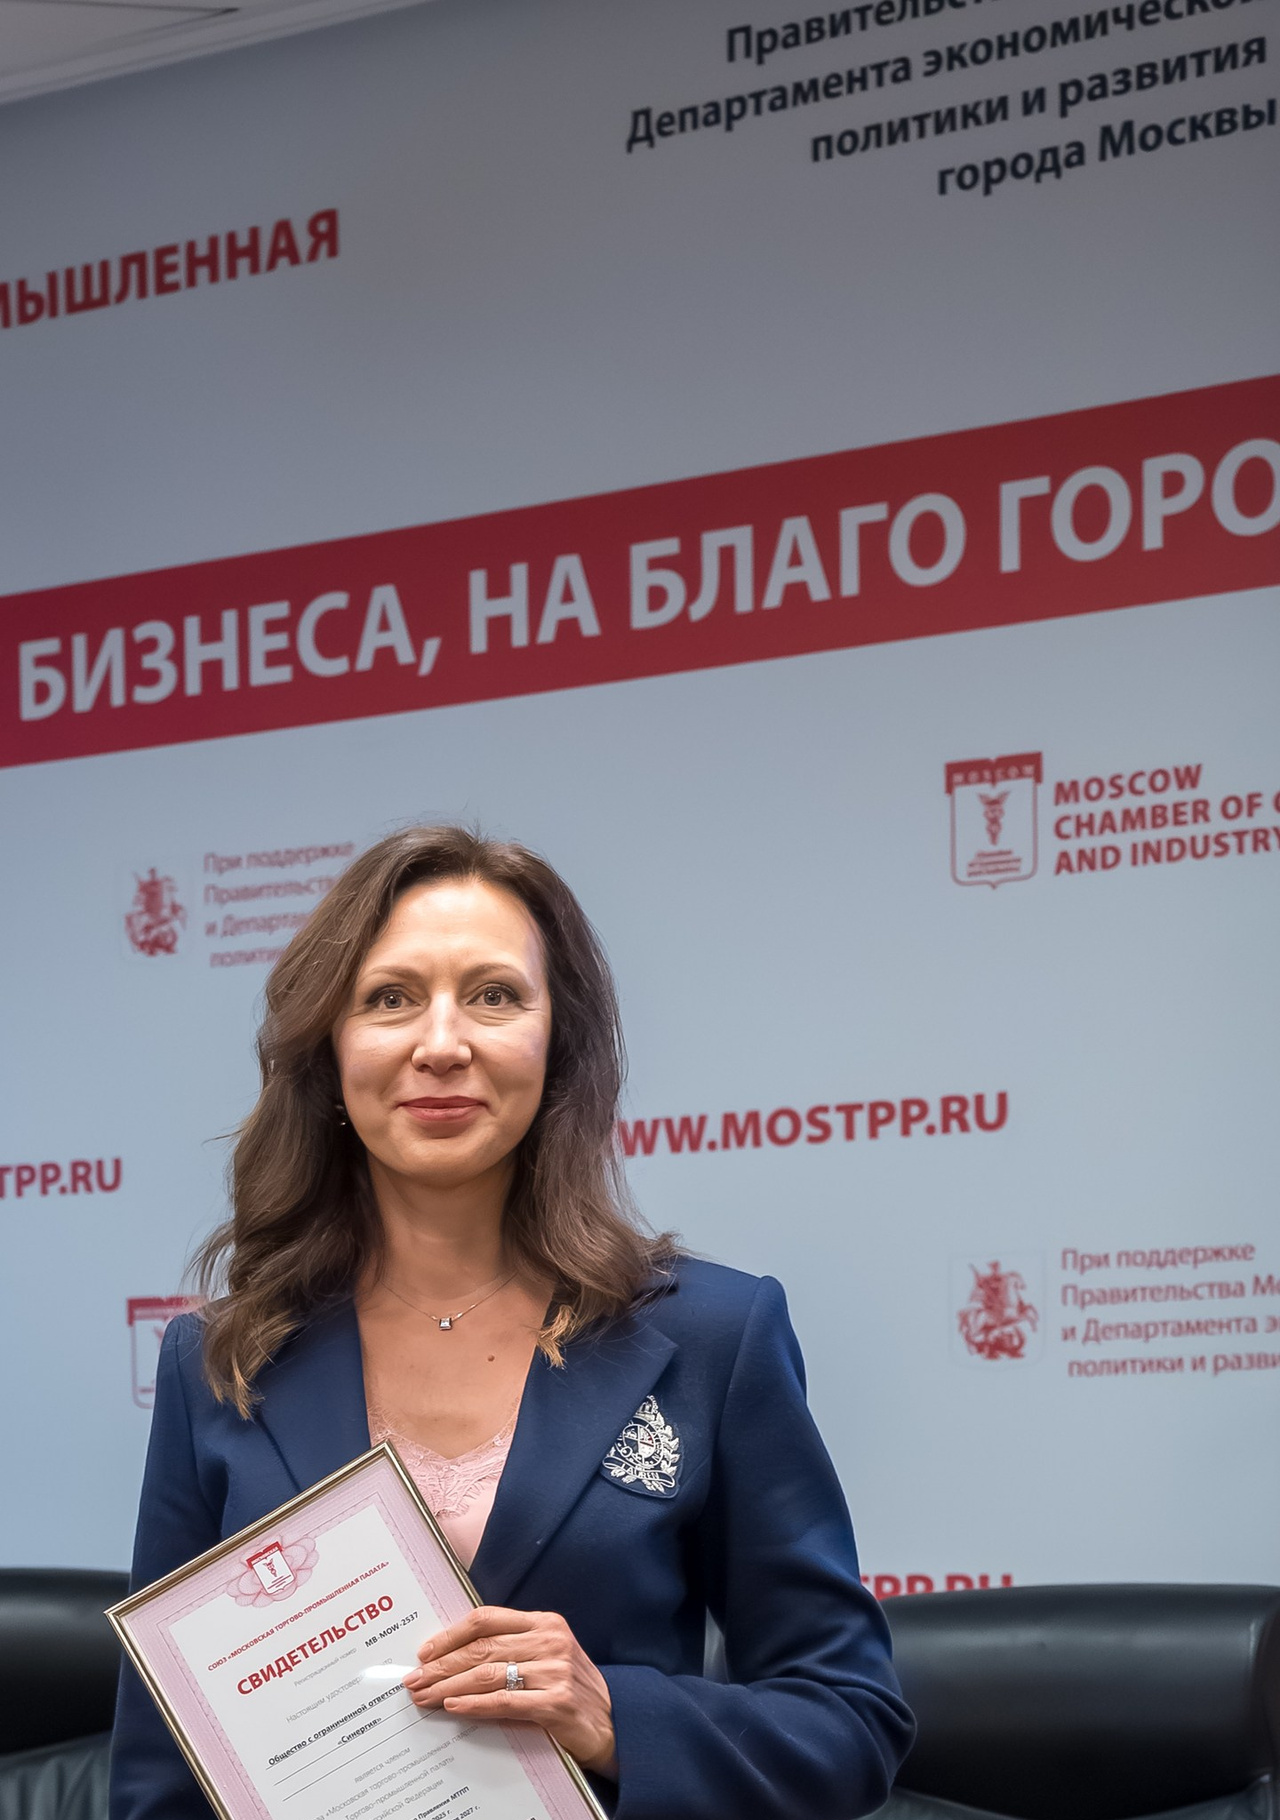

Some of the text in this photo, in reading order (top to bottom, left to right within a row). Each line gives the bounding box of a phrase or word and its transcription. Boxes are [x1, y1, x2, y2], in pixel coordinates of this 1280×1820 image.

[726, 0, 983, 65] Правитель
[626, 0, 1253, 153] Департамента экономическ
[811, 36, 1267, 162] политики и развития
[938, 99, 1277, 196] города Москвы
[19, 583, 442, 722] БИЗНЕСА,
[469, 553, 602, 655] НА
[629, 492, 967, 631] БЛАГО
[1054, 764, 1203, 806] MOSCOW
[1054, 799, 1211, 841] CHAMBER
[1220, 792, 1264, 821] OF
[1054, 845, 1122, 876] AND
[616, 1091, 1009, 1158] WW.MOSTPP.RU
[1061, 1243, 1256, 1275] При поддержке
[1061, 1281, 1246, 1311] Правительства
[1061, 1326, 1077, 1342] и
[1082, 1316, 1258, 1345] Департамента
[1068, 1357, 1184, 1378] политики
[1191, 1354, 1207, 1373] и
[207, 1656, 228, 1672] СОЮЗ
[273, 1577, 360, 1632] ТОРГОВО-ПРОМЫШЛЕННАЯ
[237, 1595, 394, 1695] СВИДЕТЕЛЬСТВО
[364, 1611, 419, 1648] MB-MOW-2537
[268, 1740, 309, 1768] Общество
[313, 1703, 370, 1742] ограниченной
[367, 1682, 407, 1708] ответстве
[285, 1697, 326, 1724] Настоящим
[337, 1717, 384, 1748] «Синергия»
[449, 1785, 470, 1801] МТПП
